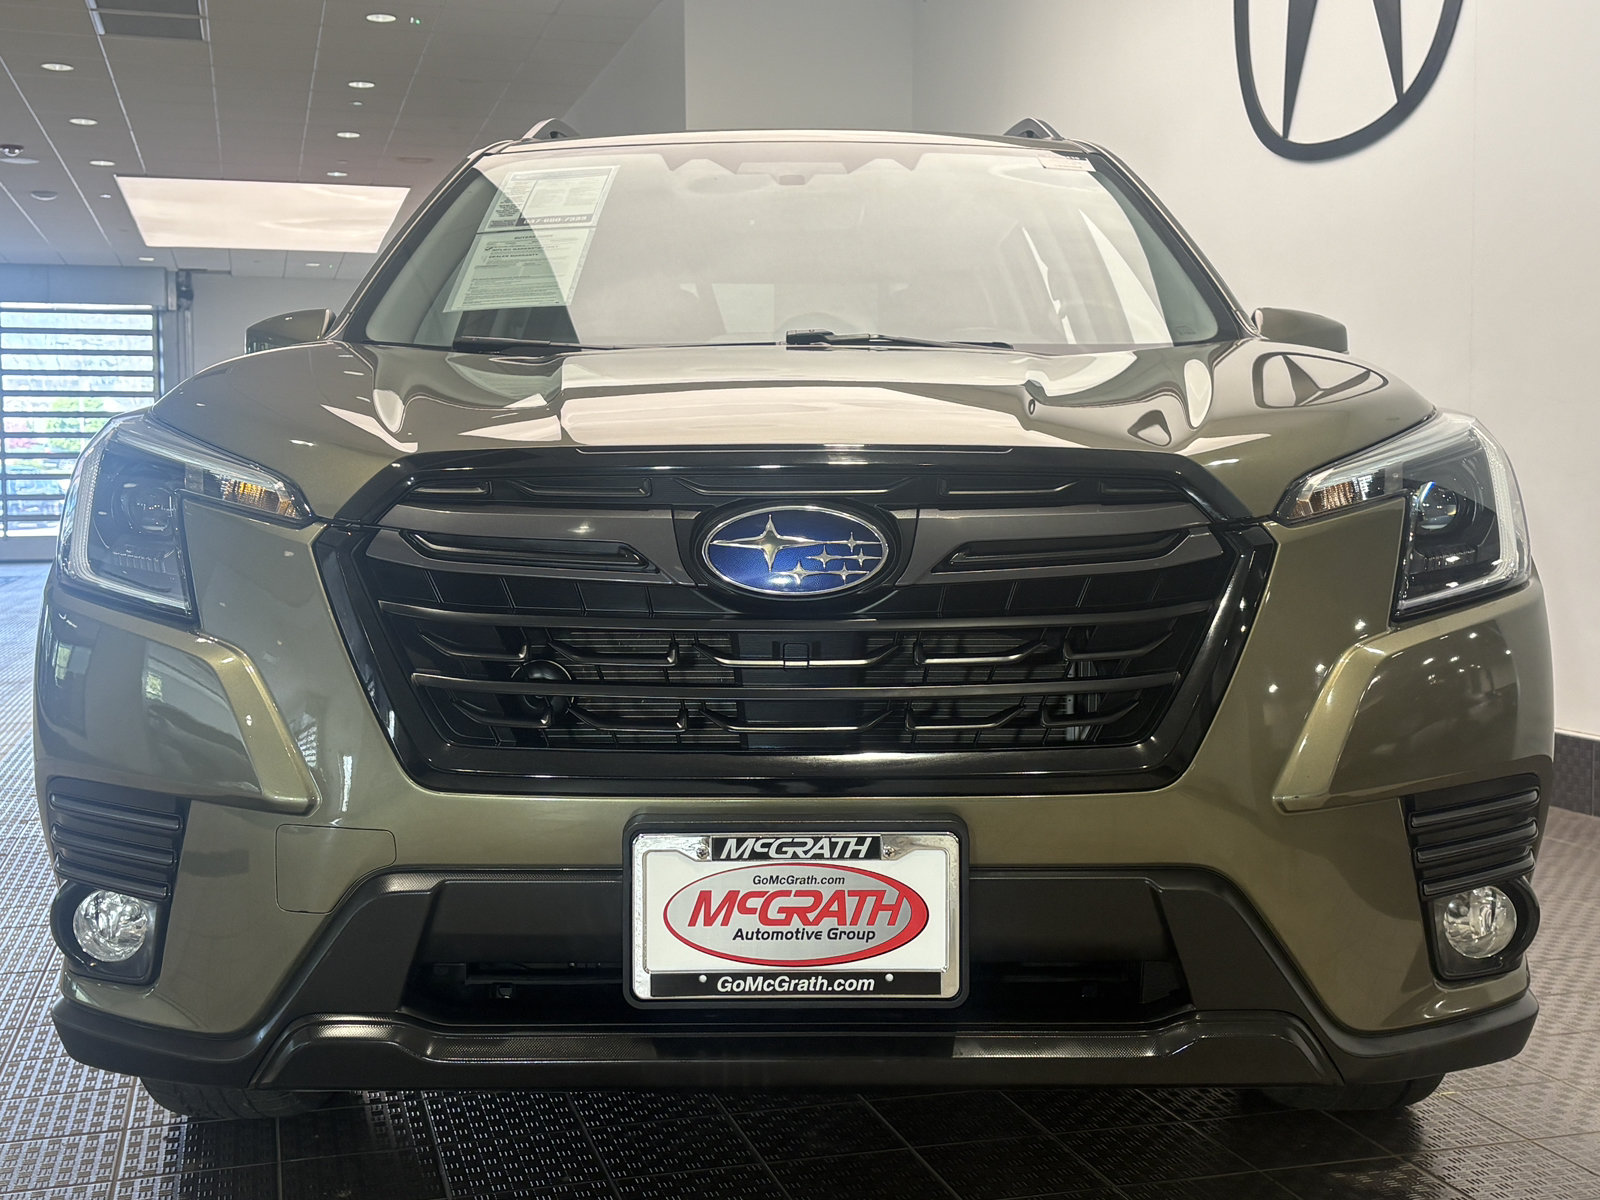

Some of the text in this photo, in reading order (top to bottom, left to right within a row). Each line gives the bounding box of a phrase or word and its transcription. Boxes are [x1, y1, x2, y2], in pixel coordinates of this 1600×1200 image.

[752, 875, 845, 887] GoMcGrath.com
[732, 927, 876, 944] Automotive Group
[716, 974, 875, 994] GoMcGrath.com
